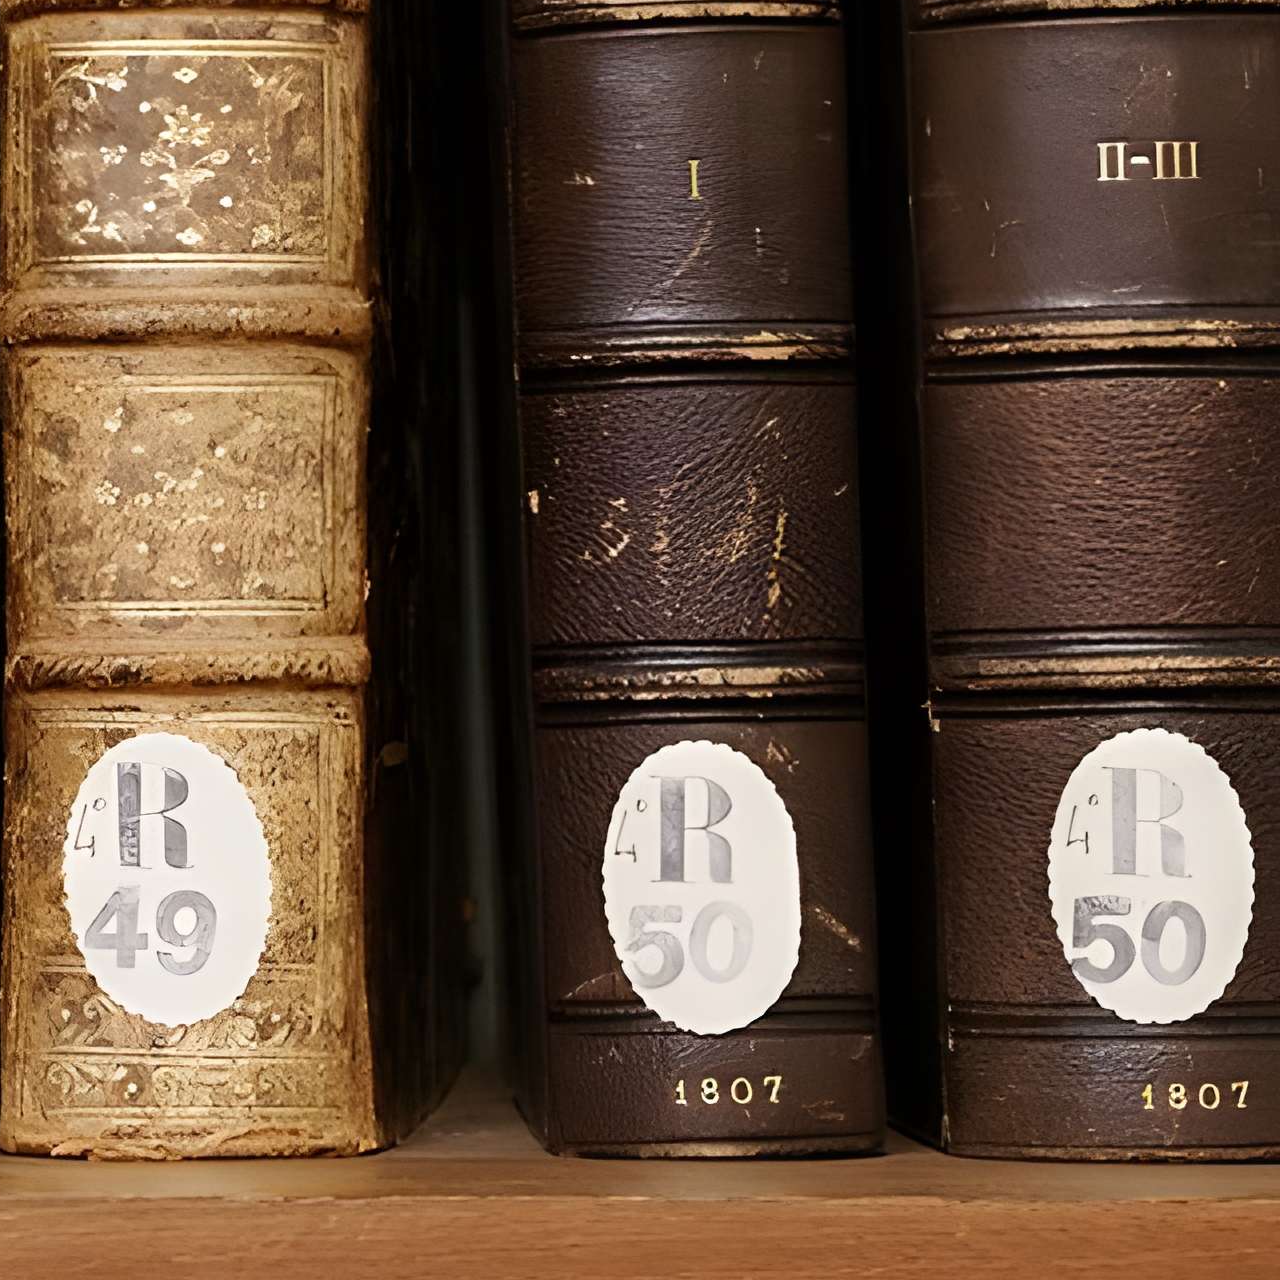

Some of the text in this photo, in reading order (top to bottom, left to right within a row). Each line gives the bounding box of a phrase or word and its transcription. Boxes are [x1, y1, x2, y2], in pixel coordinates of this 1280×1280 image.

[687, 159, 703, 200] I
[1096, 141, 1201, 182] II-III
[115, 761, 195, 870] R
[650, 775, 734, 884] R
[1100, 766, 1193, 879] R
[85, 885, 218, 976] 49
[625, 898, 757, 990] 50
[1071, 894, 1208, 987] 50
[674, 1075, 783, 1108] 1807
[1141, 1080, 1249, 1111] 1807
